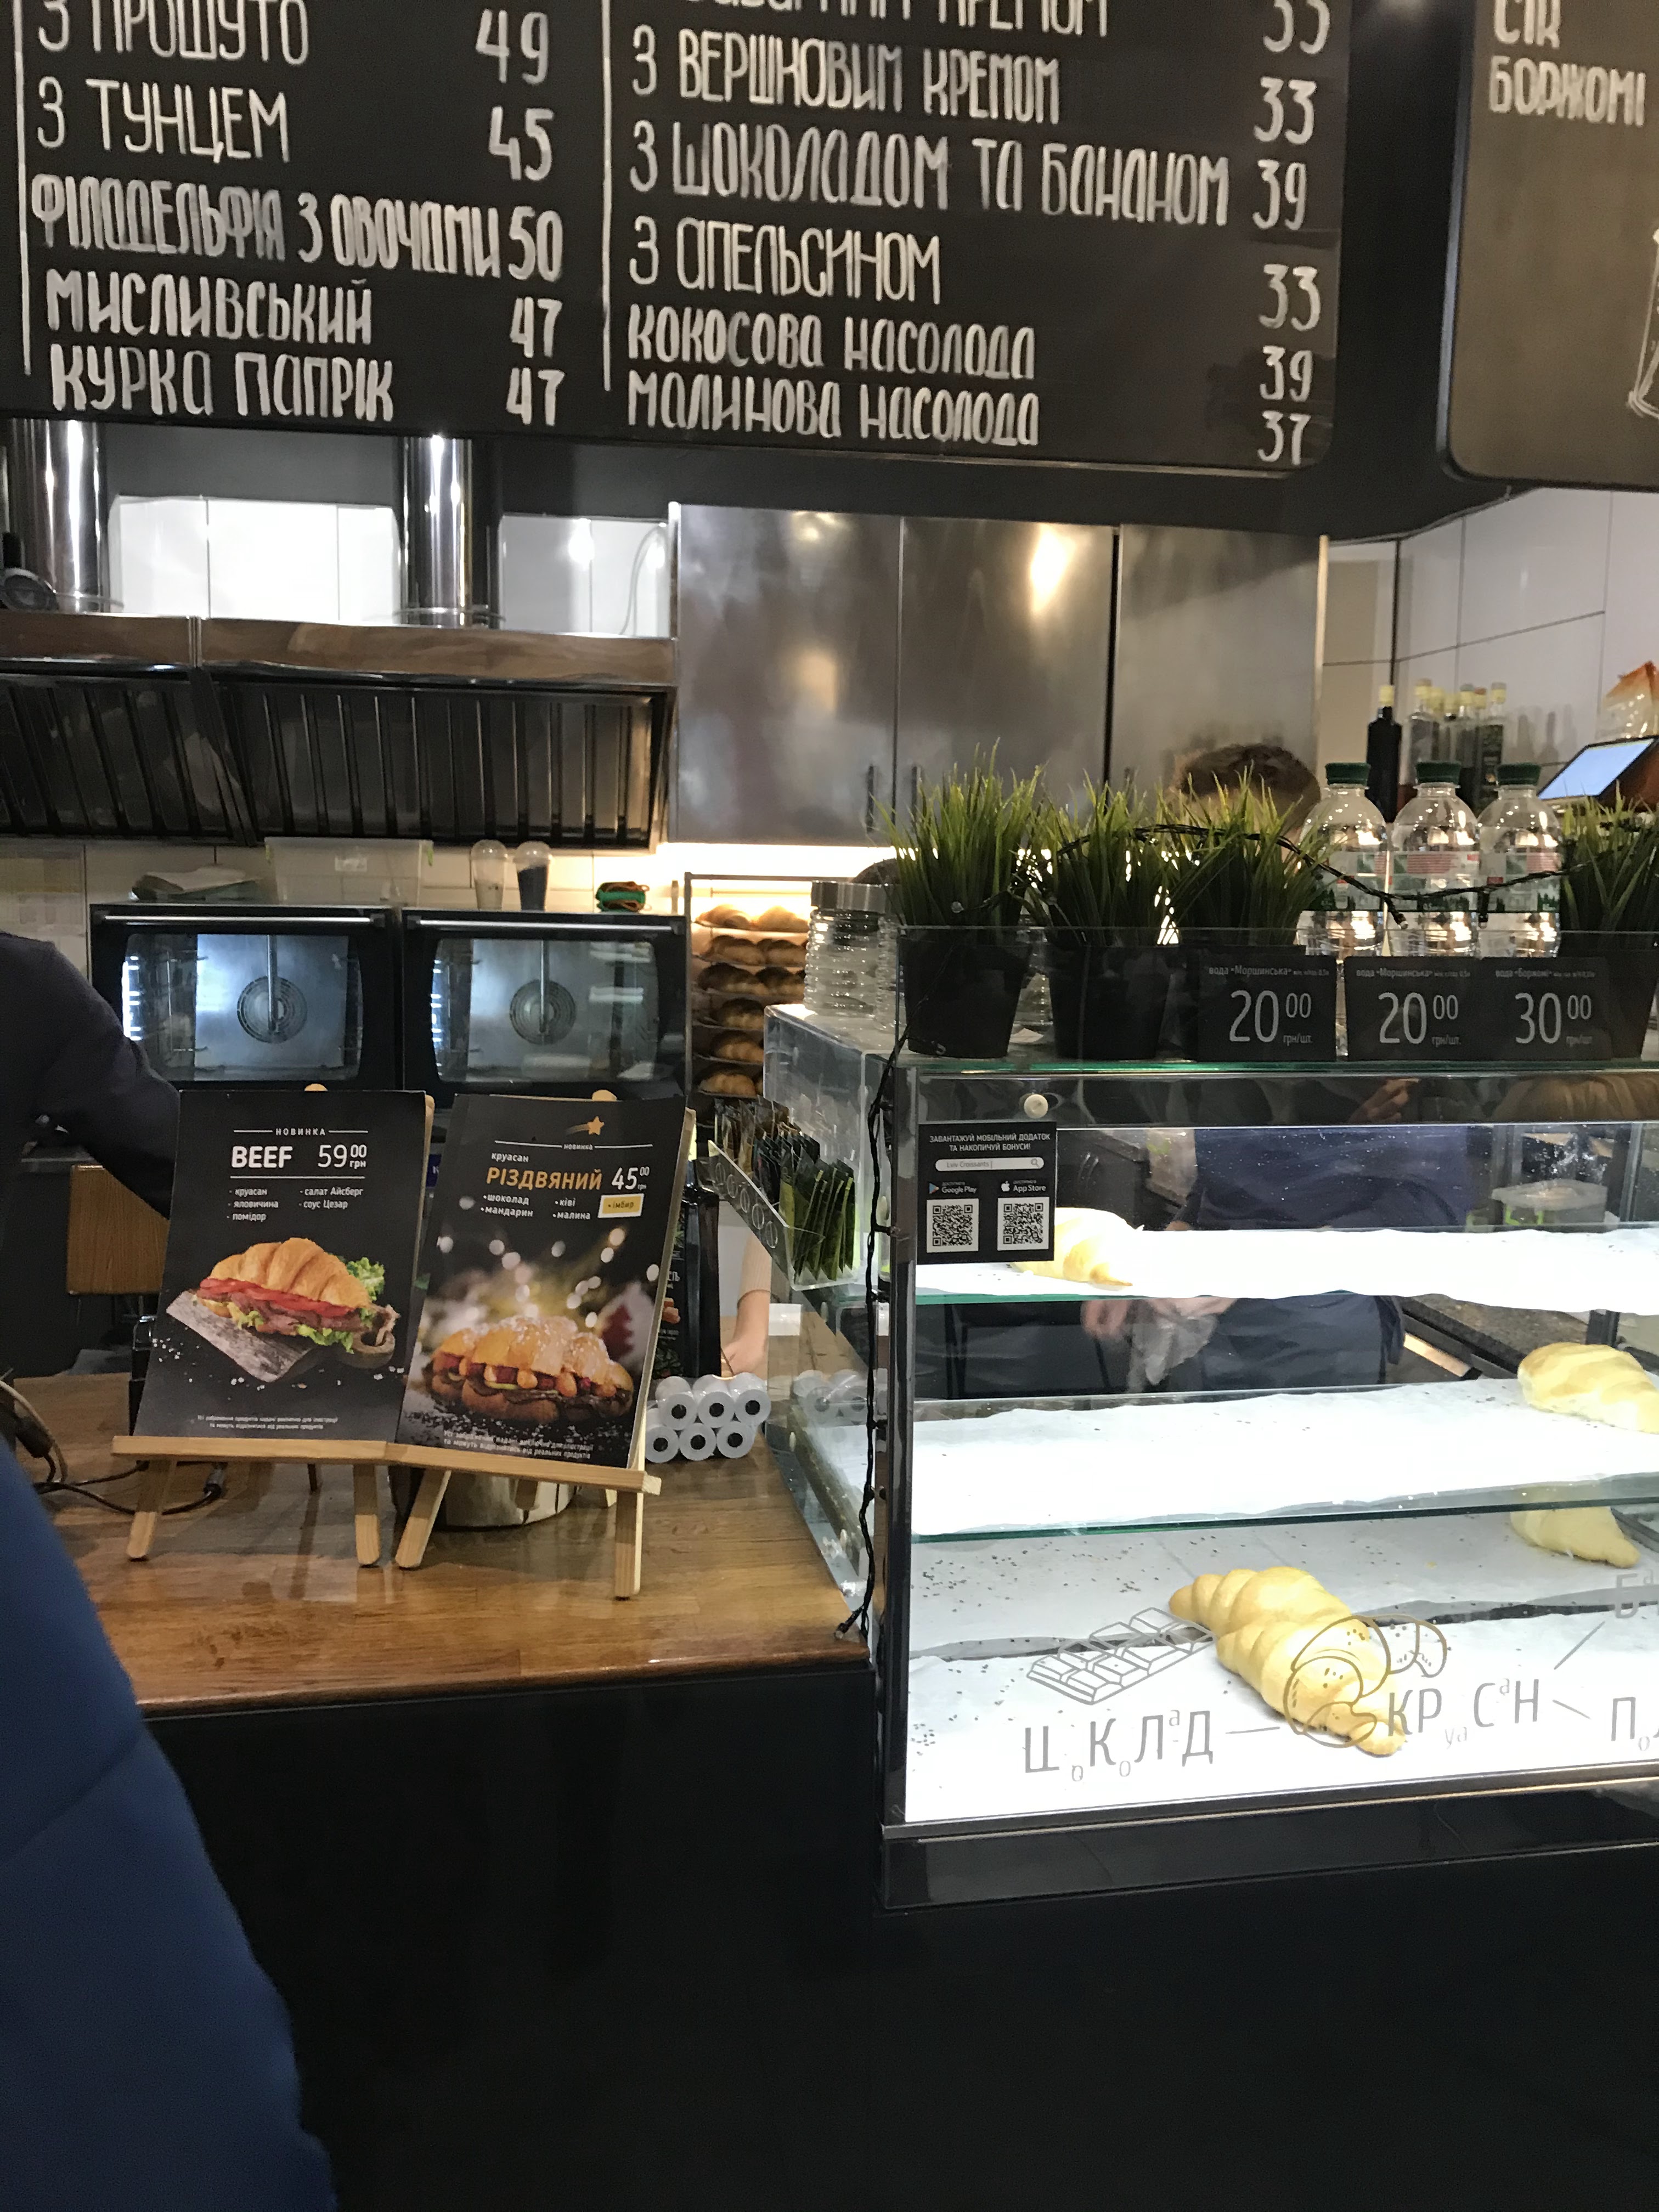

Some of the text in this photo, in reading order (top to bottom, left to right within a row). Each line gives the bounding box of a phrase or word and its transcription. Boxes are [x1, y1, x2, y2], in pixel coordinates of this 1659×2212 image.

[475, 8, 549, 85] 49
[923, 48, 1060, 125] КРЕМОМ
[1254, 76, 1318, 145] 33
[1488, 55, 1646, 127] БОРЖОМІ
[84, 78, 289, 164] ТУНЦЕМ
[488, 105, 554, 182] 45
[672, 121, 949, 210] ШОКОЛАДОМ
[971, 137, 1023, 212] ТА
[1041, 142, 1229, 227] БАНАНОМ
[1252, 159, 1307, 231] 39
[31, 173, 286, 261] ФІЛАДЕЛЬФІЯ
[330, 193, 501, 279] ОВОЧАМИ
[507, 205, 563, 283] 50
[676, 216, 941, 306] АПЕЛЬСИНОМ
[1259, 263, 1321, 331] 33
[46, 268, 563, 359] МИСЛИВСЬКИЙ 47
[627, 303, 1313, 402] КОКОСОВА НАСОЛОДА 39
[49, 343, 566, 427] КУРКА ПАПРІК 47
[628, 369, 1312, 466] МАЛИНОВА НАСОЛОДА 37
[1209, 966, 1228, 976] вода
[1229, 990, 1311, 1042] 20 00
[1378, 992, 1458, 1043] 20 00
[1515, 992, 1592, 1043] 30 00
[275, 1127, 326, 1136] НОВИНКА
[929, 1133, 1051, 1143] ЗАВАНТАЖУЙ МОБІЛЬНИЙ ДОДАТОК
[231, 1144, 367, 1168] BEEF 59 00
[491, 1152, 529, 1163] круасан
[960, 1143, 1001, 1152] НАКОПИЧУЙ
[349, 1160, 366, 1170] грн
[486, 1167, 602, 1190] РІЗДВЯНИЙ
[611, 1167, 639, 1190] 45
[234, 1187, 268, 1198] круасан
[330, 1186, 364, 1197] Айсберг
[487, 1194, 529, 1206] шоколад
[560, 1198, 576, 1206] ківі
[941, 1186, 963, 1195] Google
[303, 1199, 348, 1210] соус Цезар
[485, 1206, 533, 1218] мандарин
[557, 1212, 591, 1220] малина
[232, 1212, 267, 1222] помідор
